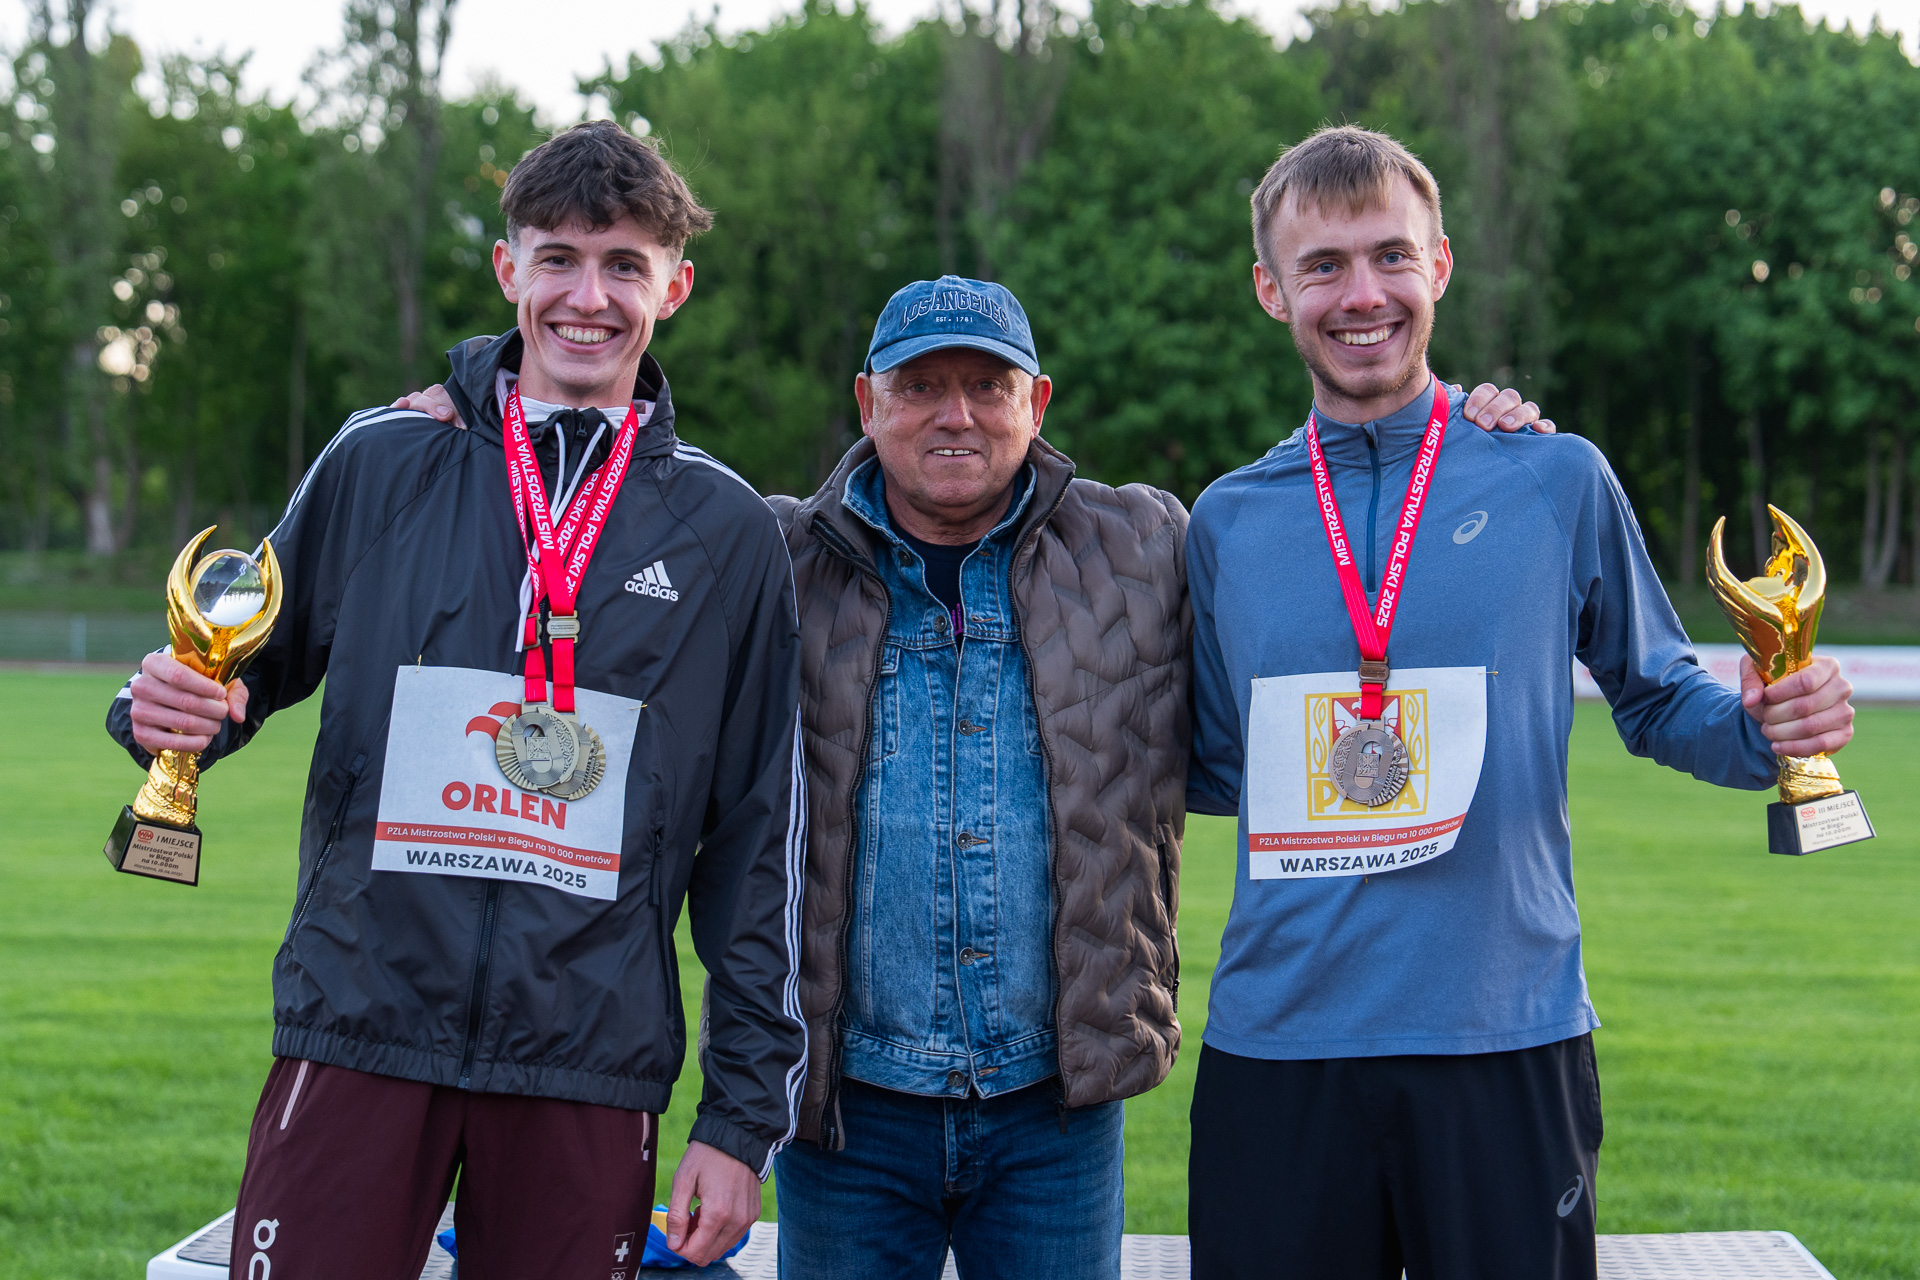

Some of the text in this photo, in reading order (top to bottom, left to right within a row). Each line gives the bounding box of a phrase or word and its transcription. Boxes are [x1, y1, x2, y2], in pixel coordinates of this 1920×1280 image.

[931, 290, 1009, 334] ANGELES
[509, 396, 526, 442] POLSKI
[517, 442, 555, 550] MISTRZOSTWA
[568, 423, 635, 577] MISTRZOSTWA POLSKI
[569, 473, 599, 522] POLSKI
[1315, 461, 1350, 566] MISTRZOSTWA
[1376, 419, 1443, 628] MISTRZOSTWA POLSKI 2025
[624, 579, 679, 602] adidas
[441, 781, 567, 830] ORLEN
[1827, 800, 1855, 811] MIEJSCE
[132, 843, 194, 860] Mistrzostwa Polski
[161, 836, 195, 849] MIEJSCE
[386, 826, 409, 837] PZLA
[410, 827, 467, 840] Mistrzostwa
[468, 831, 496, 843] Polski
[508, 835, 534, 849] Biegu
[535, 842, 547, 851] na
[547, 844, 556, 854] 10
[556, 848, 574, 859] 000
[575, 853, 612, 866] metrów
[1259, 837, 1280, 846] PZLA
[1281, 835, 1334, 846] Mistrzostwa
[1335, 833, 1361, 844] Polski
[1371, 831, 1396, 844] Biegu
[1396, 832, 1408, 840] na
[1409, 829, 1417, 838] 10
[1418, 826, 1433, 837] 000
[1433, 818, 1460, 833] metrów
[156, 853, 175, 863] Biegu
[405, 850, 588, 889] WARSZAWA 2025
[1280, 841, 1439, 873] WARSZAWA 2025
